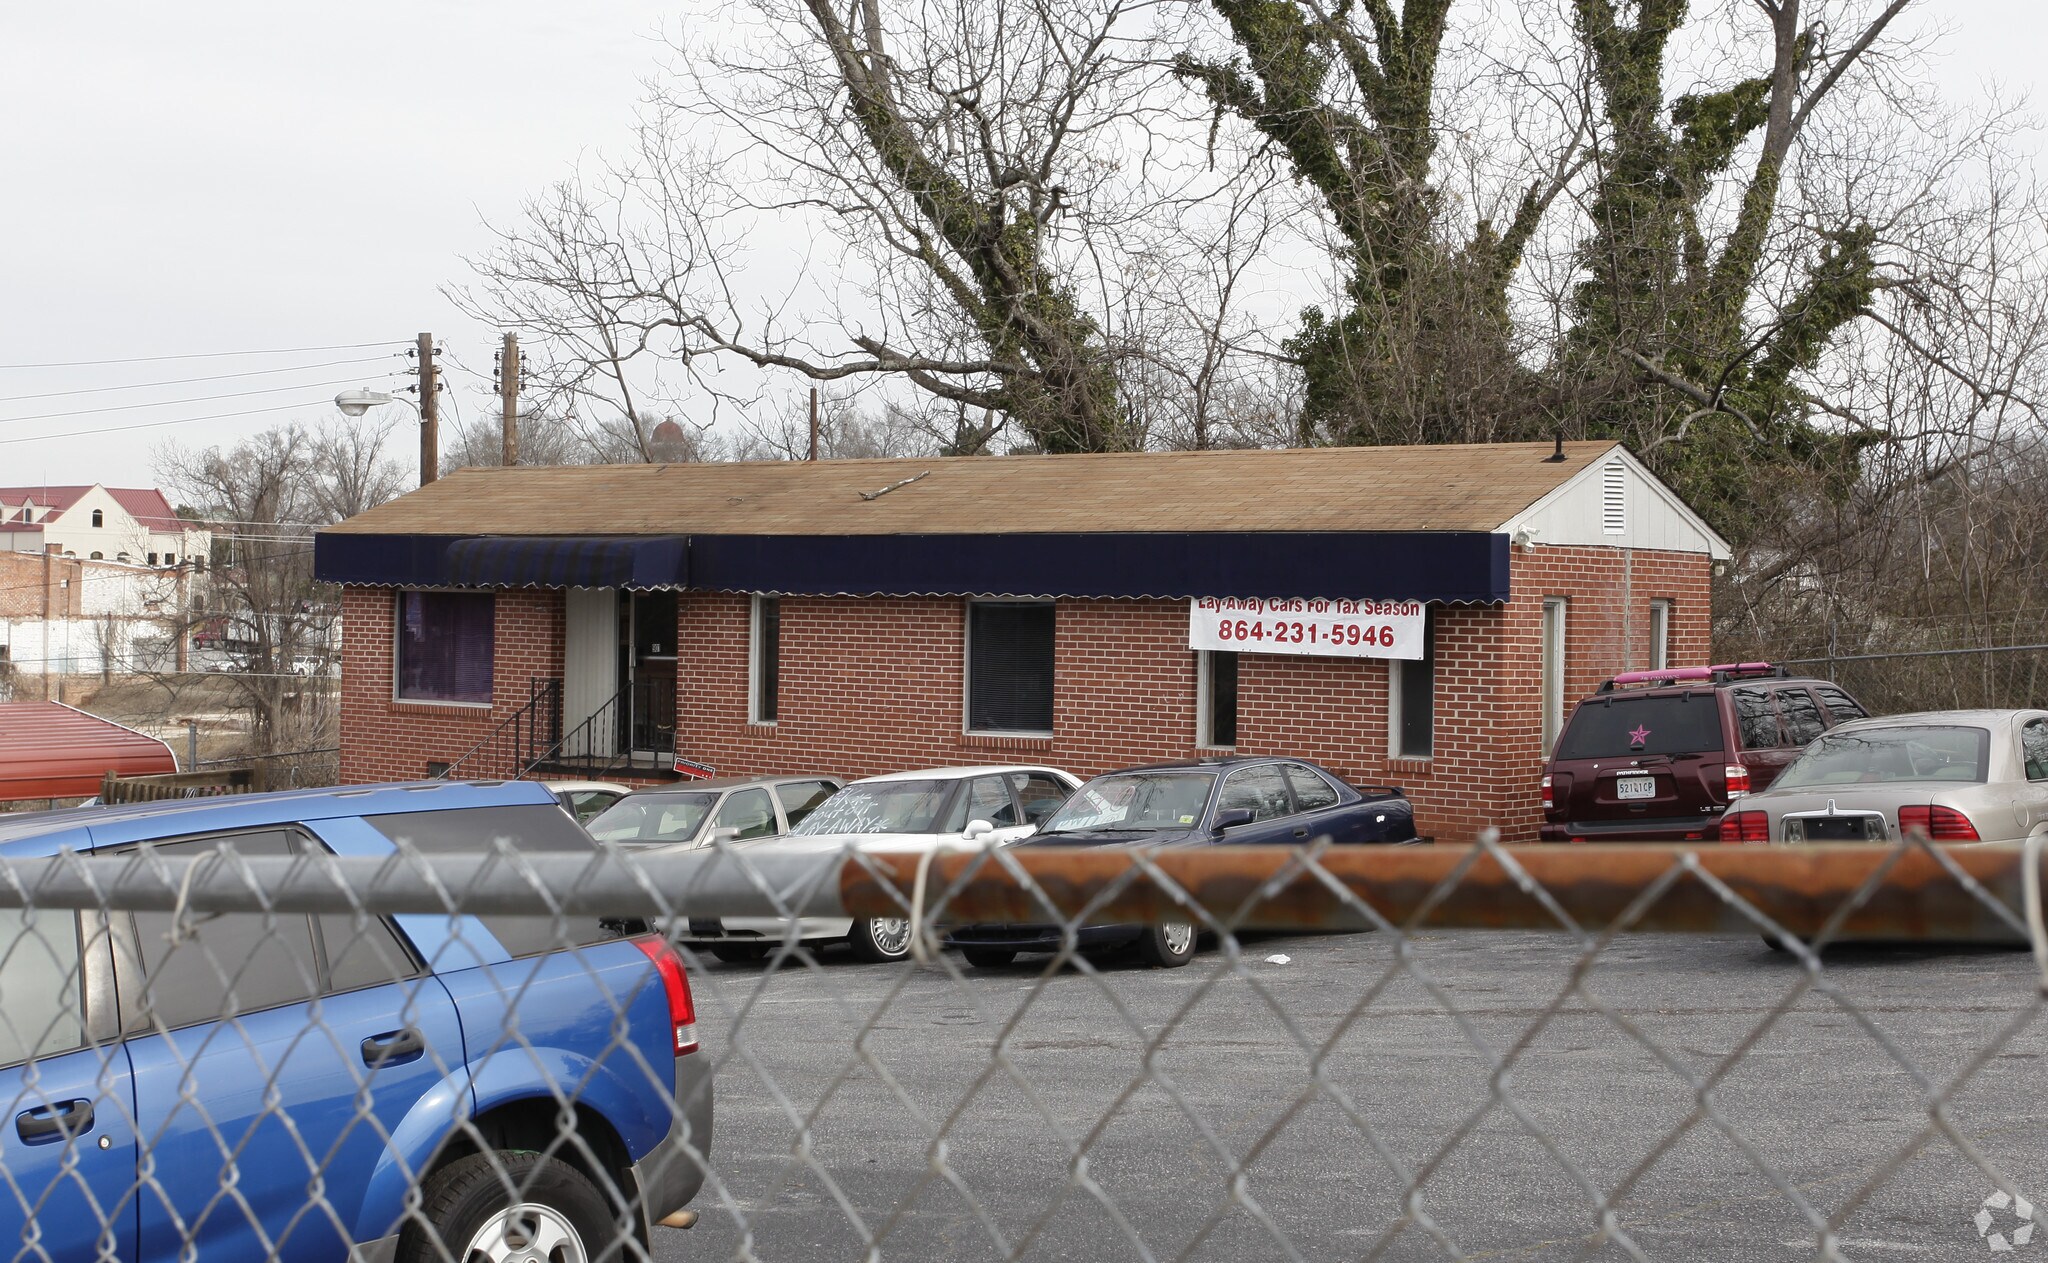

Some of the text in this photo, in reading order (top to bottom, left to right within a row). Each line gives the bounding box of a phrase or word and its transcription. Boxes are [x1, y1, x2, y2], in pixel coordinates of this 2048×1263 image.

[1269, 598, 1303, 612] Cars
[1307, 600, 1330, 613] For
[1337, 599, 1360, 614] Tax
[1365, 600, 1420, 616] Season
[1218, 619, 1395, 647] 864-231-5946
